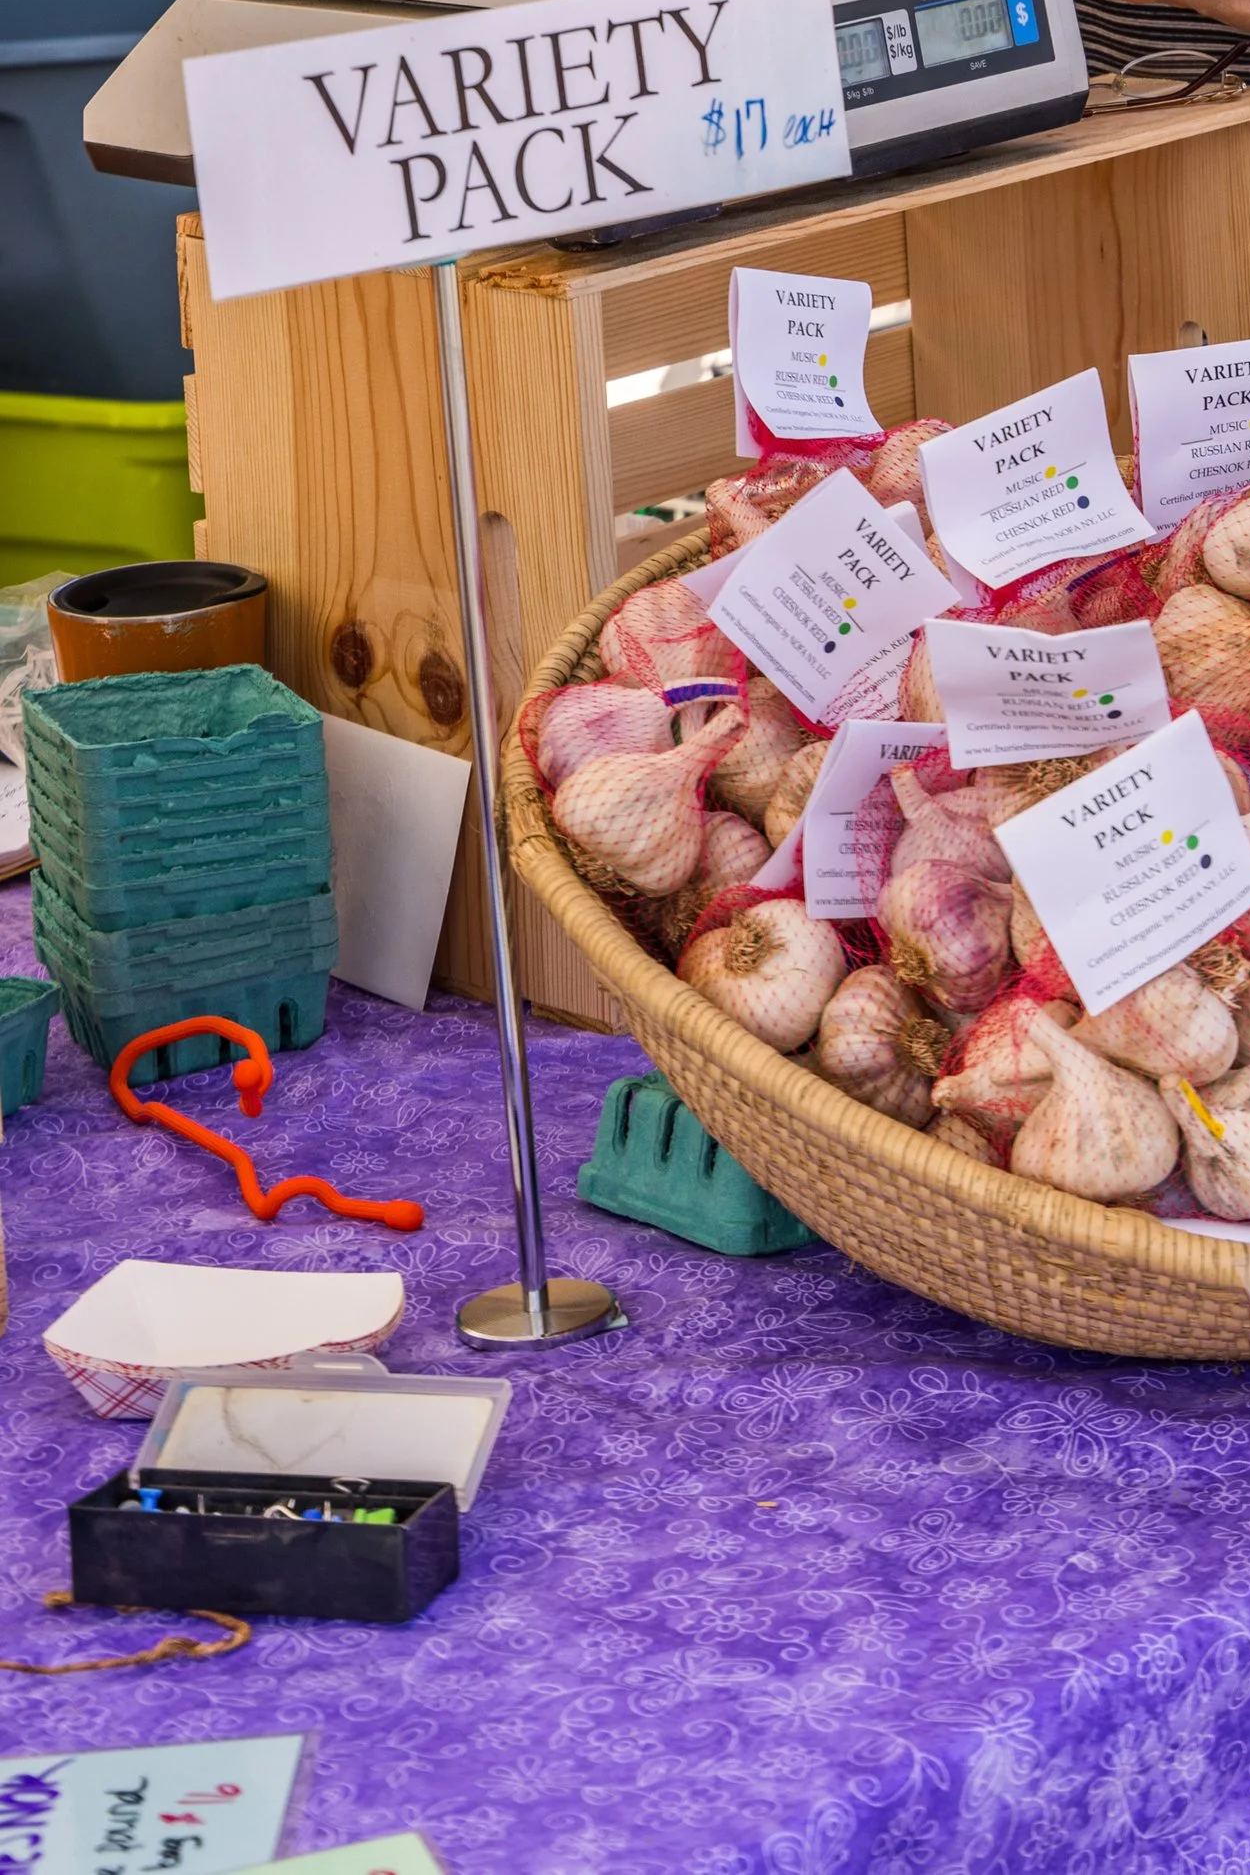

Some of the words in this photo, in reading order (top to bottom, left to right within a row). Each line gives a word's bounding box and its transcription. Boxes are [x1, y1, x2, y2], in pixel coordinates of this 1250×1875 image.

[1015, 1, 1029, 27] $
[886, 23, 907, 41] $/lb
[889, 41, 914, 60] $/kg
[969, 59, 988, 71] SAVE
[303, 0, 729, 155] VARIETY
[846, 89, 861, 100] $/kg
[862, 87, 875, 97] $/lb
[700, 97, 767, 159] $17
[390, 112, 654, 243] PACK
[775, 289, 837, 311] VARIETY
[787, 319, 825, 339] PACK
[790, 350, 819, 364] MUSIC
[775, 370, 811, 384] RUSSIAN
[812, 373, 829, 386] RED
[776, 390, 817, 404] CHESNOK
[817, 394, 834, 405] RED
[972, 406, 1053, 453] VARIETY
[1209, 419, 1248, 435] MUSIC
[994, 440, 1046, 475] PACK
[1191, 441, 1243, 459] RUSSIAN
[1188, 461, 1245, 480] CHESNOK
[1005, 471, 1044, 495] MUSIC
[989, 493, 1040, 523] RUSSIAN
[1041, 481, 1066, 501] RED
[1159, 493, 1194, 506] Certified
[995, 509, 1052, 543] CHESNOK
[1052, 501, 1077, 520] RED
[1054, 524, 1080, 539] NOFA
[855, 518, 916, 582] VARIETY
[837, 548, 881, 590] PACK
[772, 586, 811, 629] CHESNOK
[807, 622, 828, 644] RED
[986, 645, 1088, 665] VARIETY
[1009, 670, 1073, 684] PACK
[1002, 698, 1065, 710] RUSSIAN
[1067, 699, 1096, 712] RED
[1060, 763, 1155, 828] VARIETY
[1093, 803, 1155, 850] PACK
[1114, 838, 1161, 871] MUSIC
[1101, 863, 1162, 904] RUSSIAN
[1162, 845, 1188, 870] RED
[1109, 884, 1176, 927] CHESNOK
[1176, 863, 1200, 888] RED
[1164, 912, 1176, 925] by
